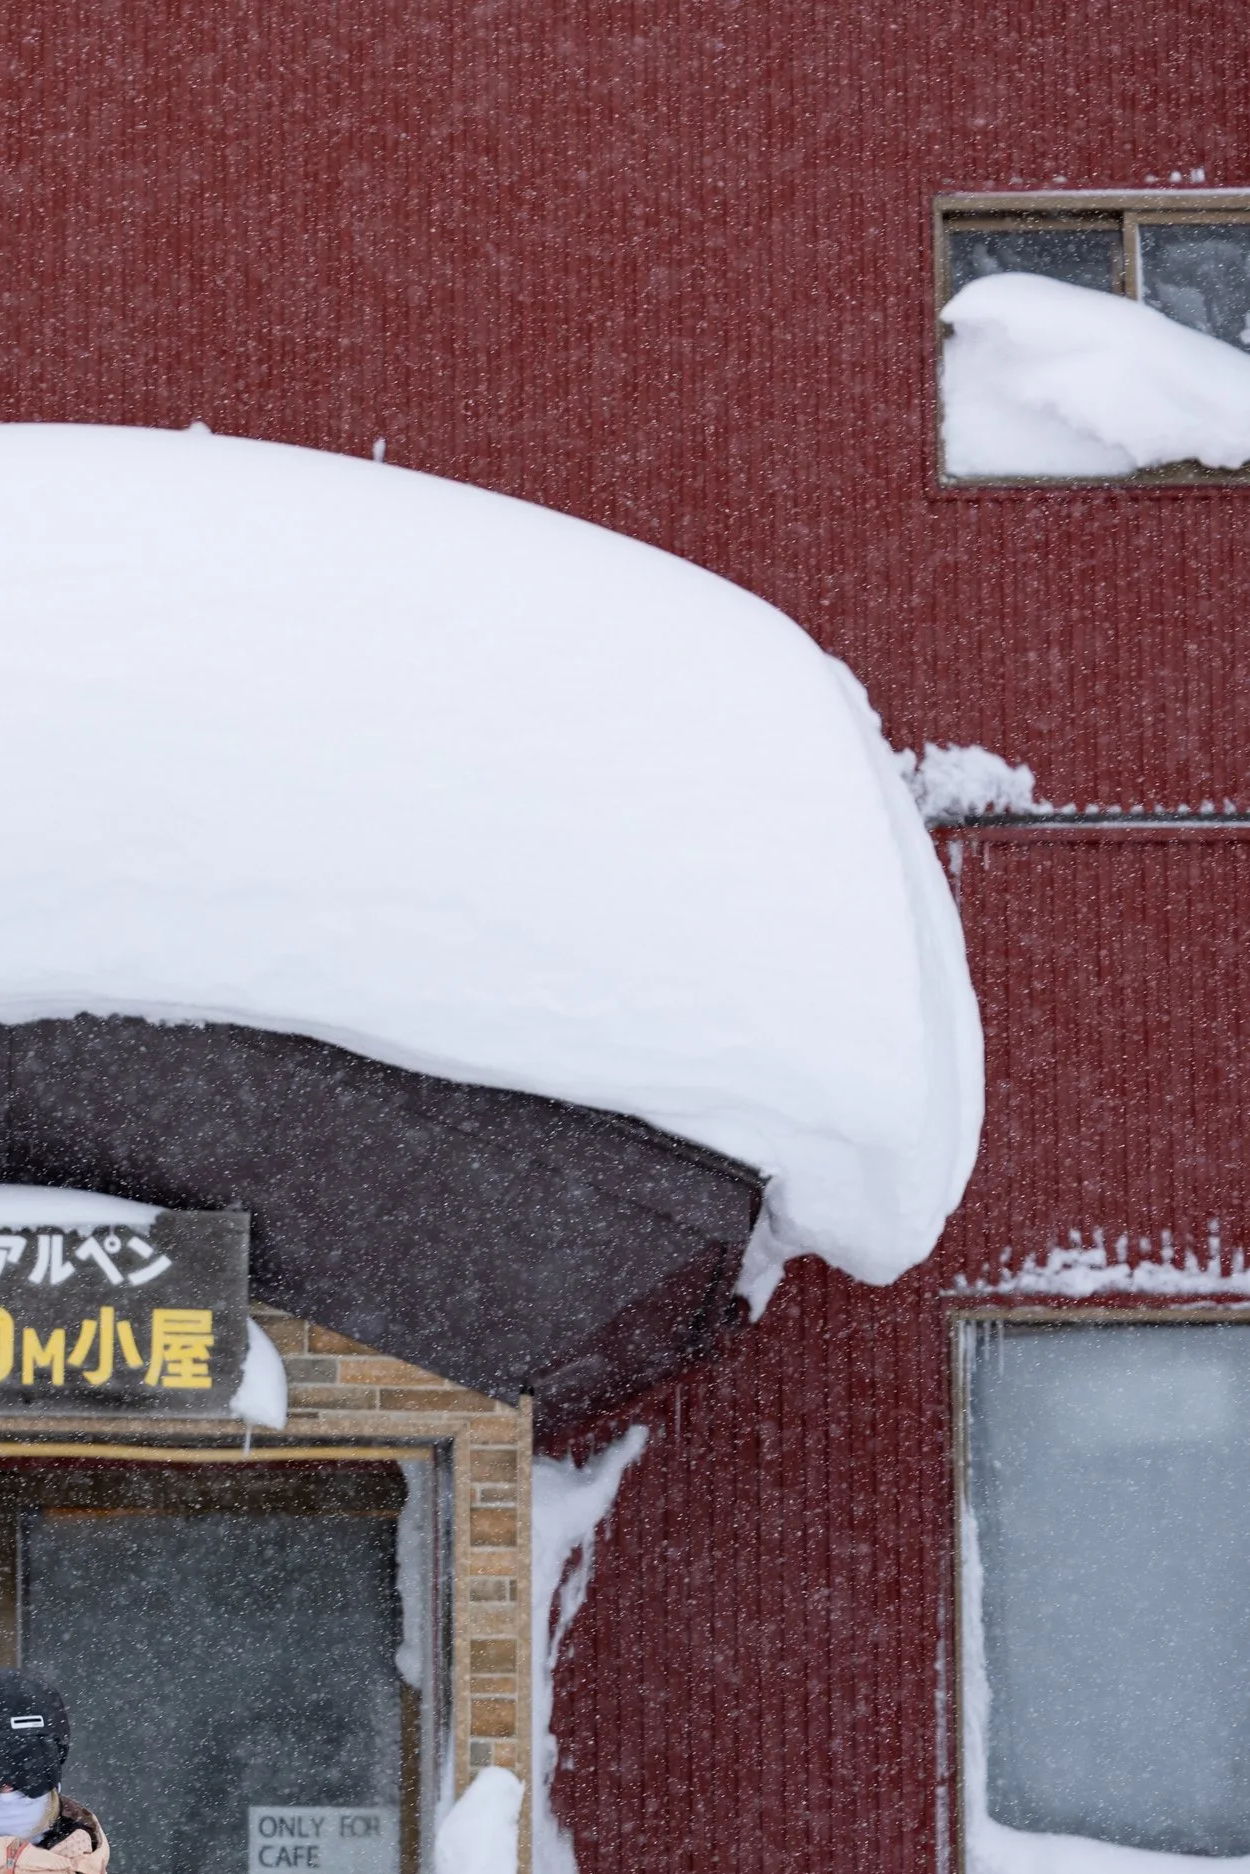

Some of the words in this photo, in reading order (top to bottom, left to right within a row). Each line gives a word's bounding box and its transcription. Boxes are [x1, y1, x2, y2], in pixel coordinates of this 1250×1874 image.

[258, 1815, 325, 1838] ONLY
[339, 1815, 381, 1838] FOR
[258, 1845, 320, 1869] CAFE
